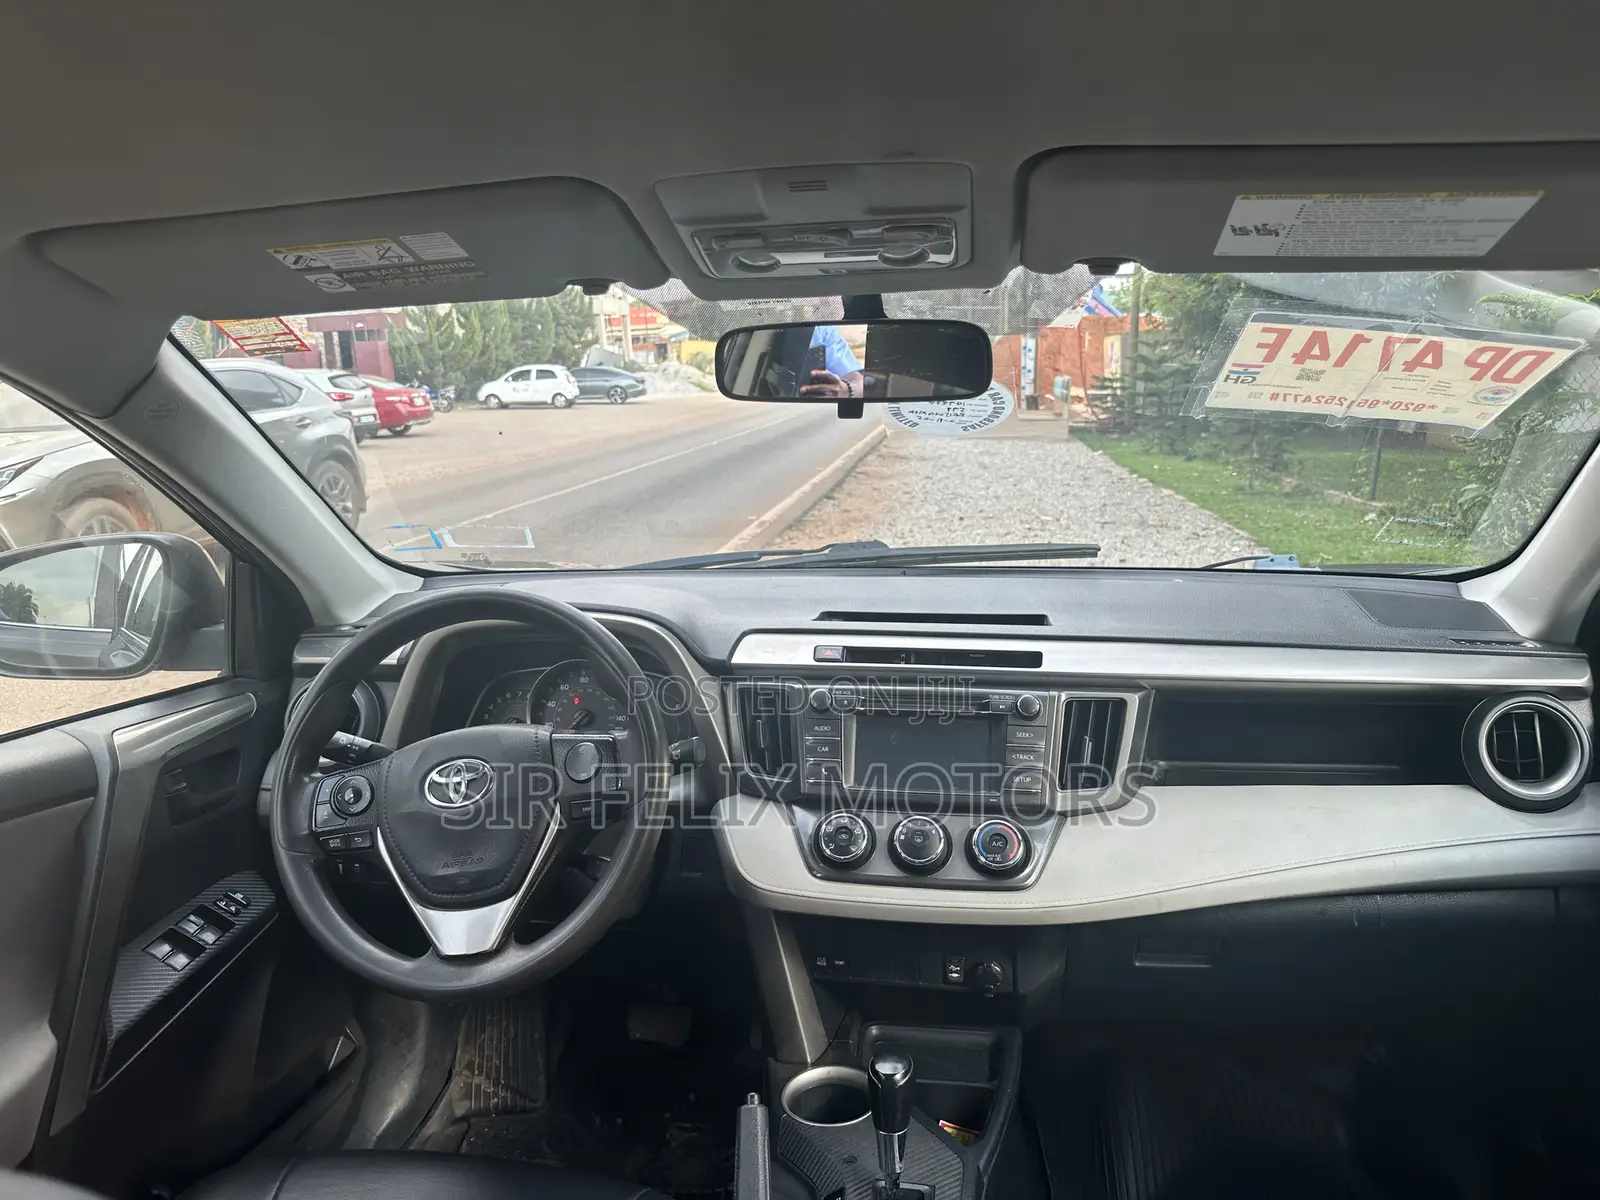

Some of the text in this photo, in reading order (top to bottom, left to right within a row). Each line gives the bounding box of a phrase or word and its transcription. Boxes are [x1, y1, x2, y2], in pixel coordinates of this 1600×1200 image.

[404, 259, 477, 274] WARNING
[580, 676, 589, 684] 80
[991, 840, 1003, 848] A/C
